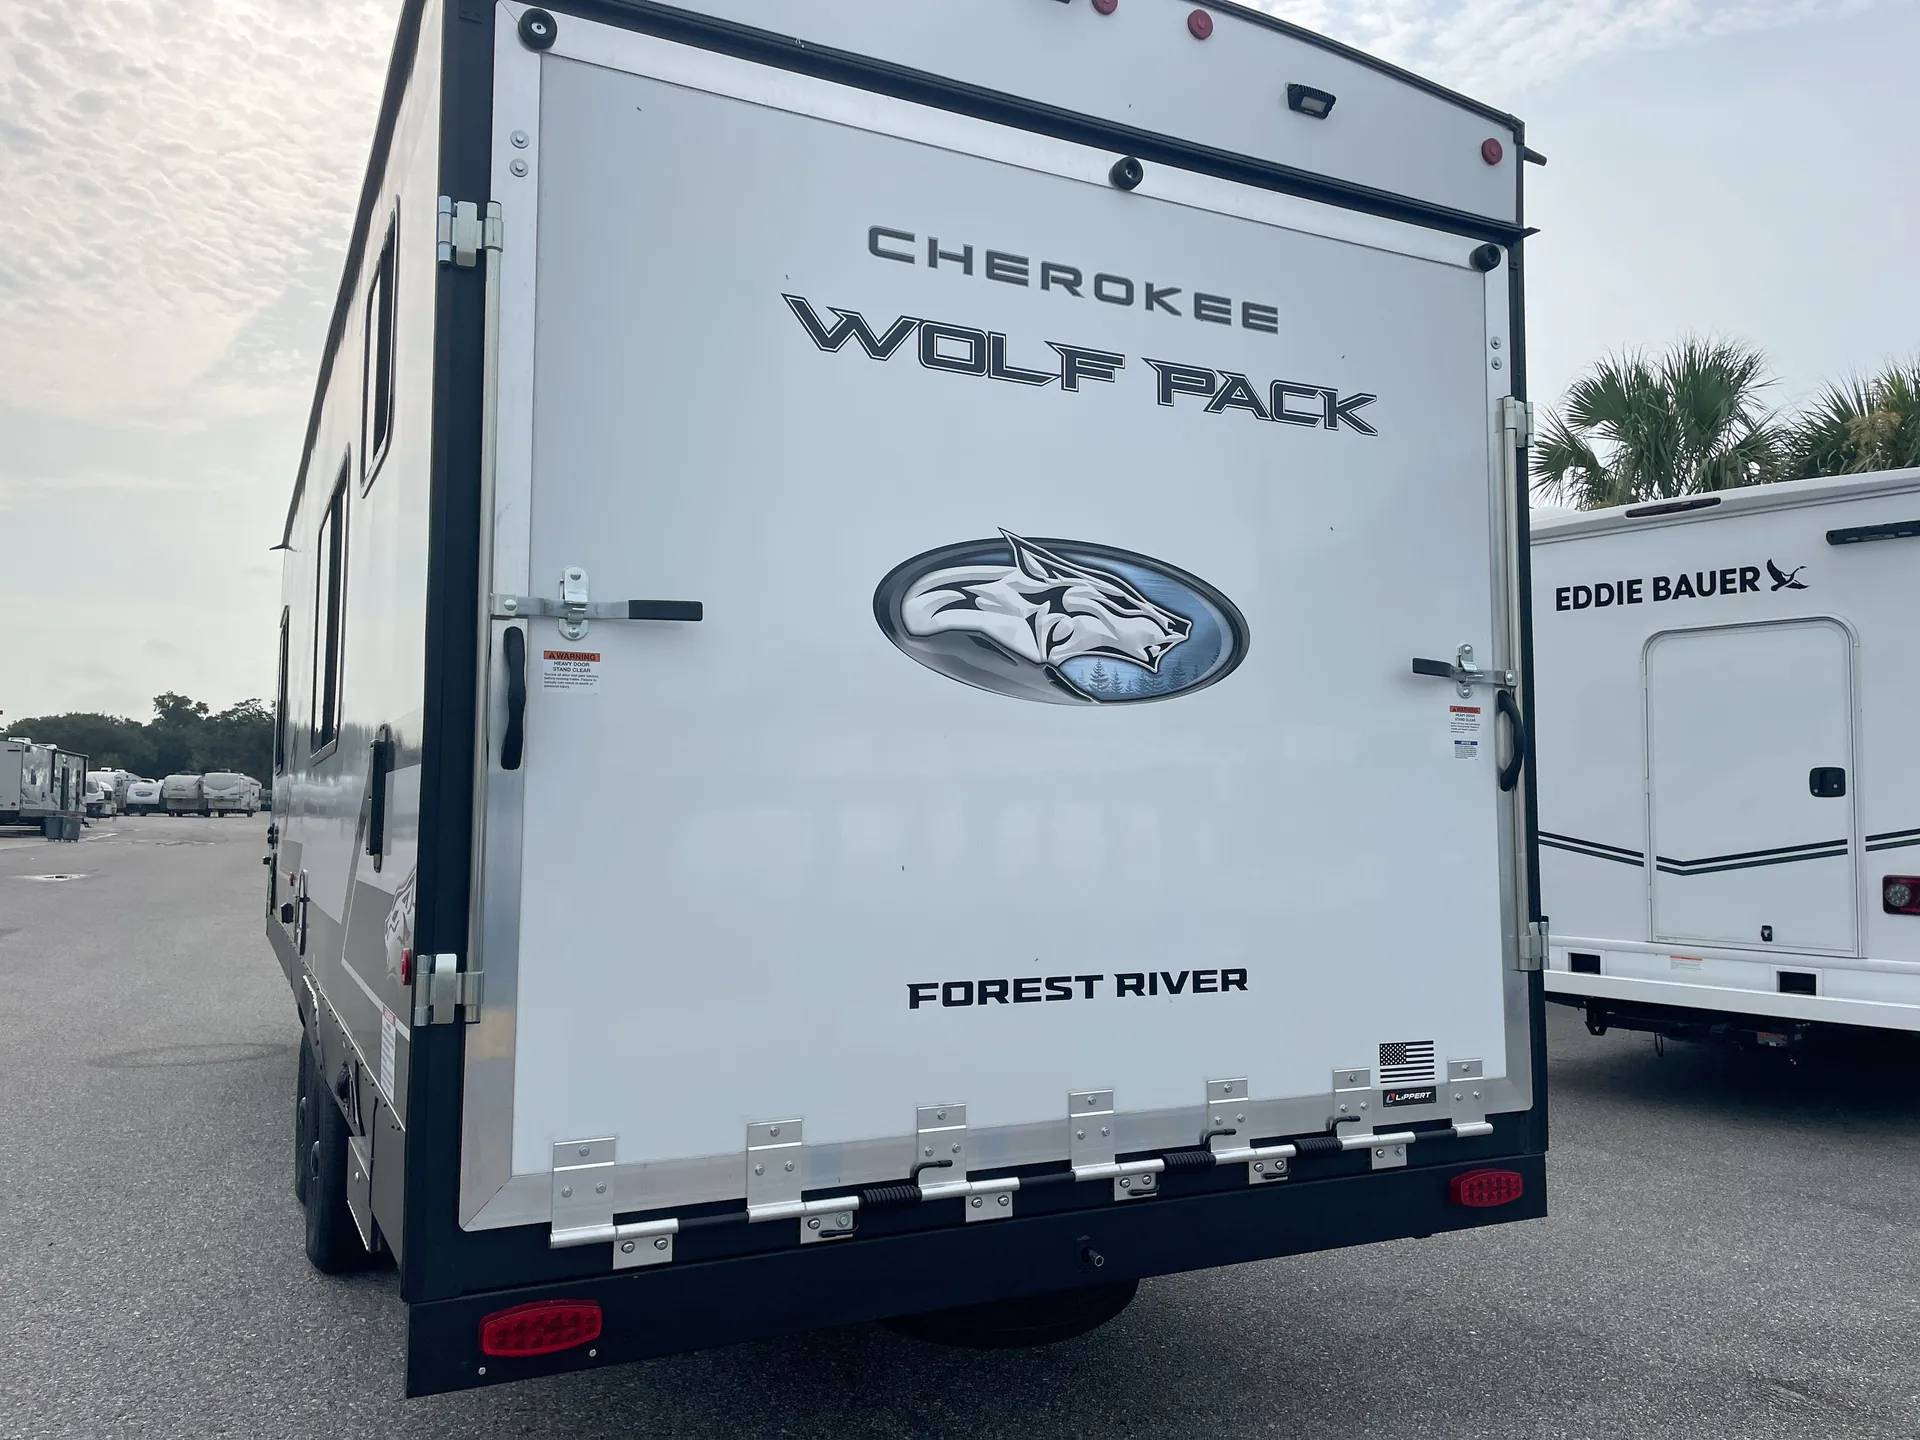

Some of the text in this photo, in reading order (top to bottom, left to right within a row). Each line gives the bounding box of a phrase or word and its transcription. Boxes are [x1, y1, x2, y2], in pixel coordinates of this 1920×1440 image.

[868, 225, 1278, 334] CHEROKEE
[780, 293, 1378, 436] WOLF PACK
[1556, 566, 1760, 611] EDDIE BAUER
[557, 652, 596, 661] WARNING
[906, 968, 1249, 1010] FOREST RIVER
